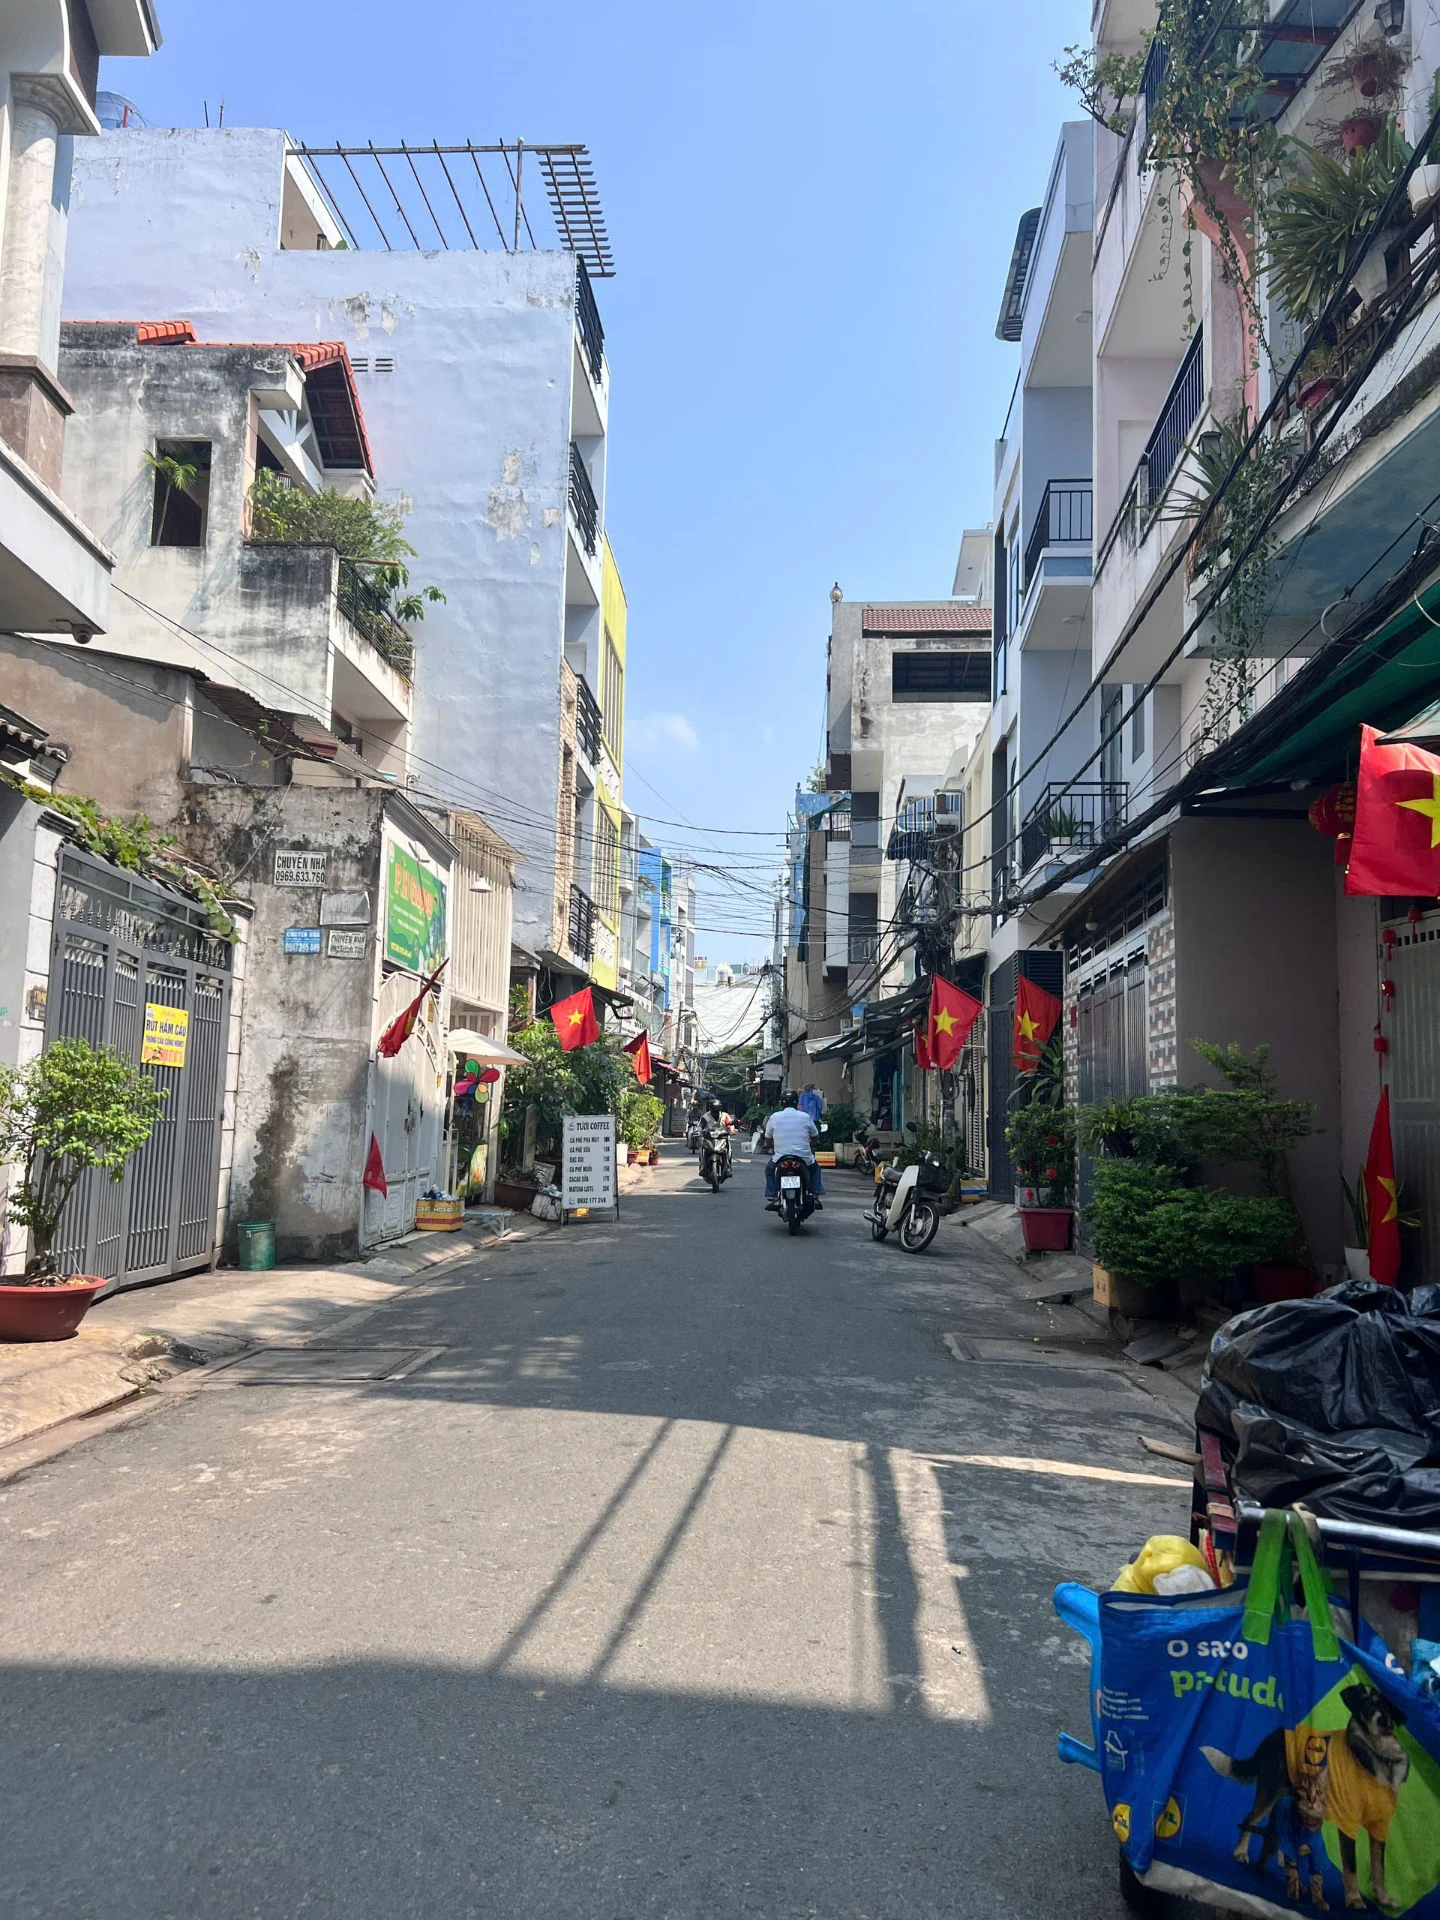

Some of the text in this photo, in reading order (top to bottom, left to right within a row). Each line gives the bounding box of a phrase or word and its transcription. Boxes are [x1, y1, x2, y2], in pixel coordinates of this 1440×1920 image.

[275, 870, 325, 883] 0969.633.760
[590, 1122, 610, 1130] COFFEE
[1167, 1639, 1189, 1658] O
